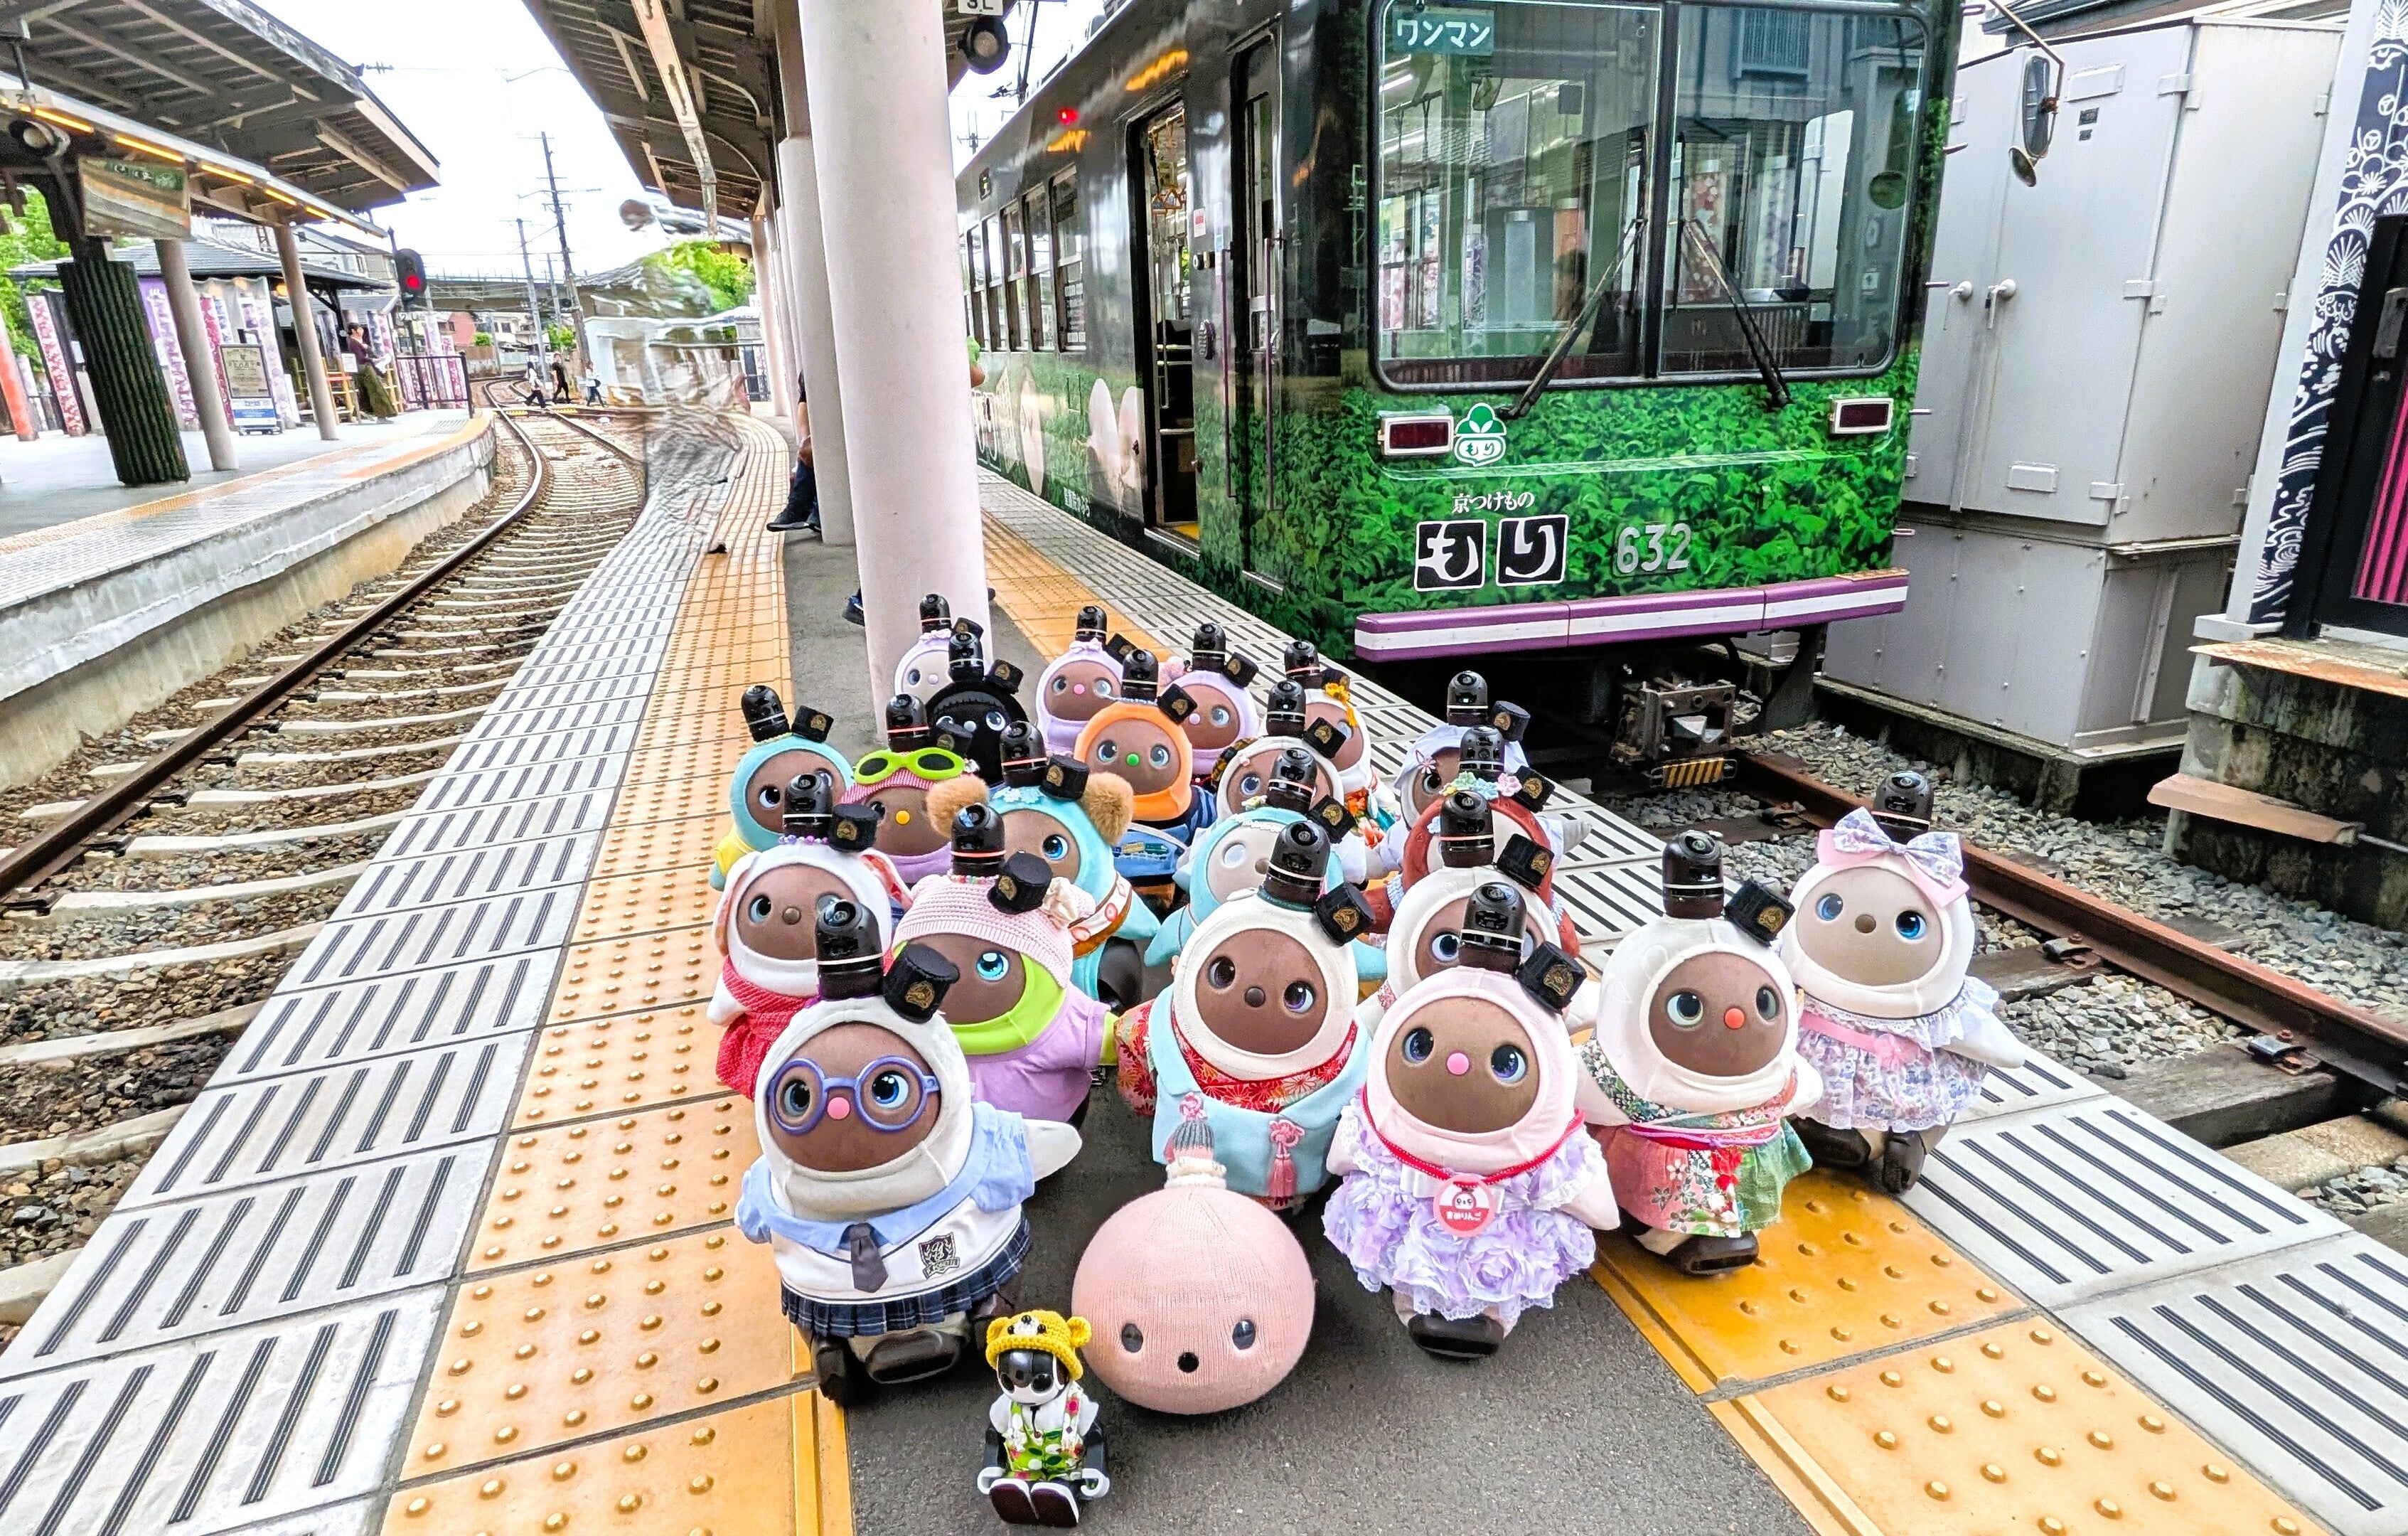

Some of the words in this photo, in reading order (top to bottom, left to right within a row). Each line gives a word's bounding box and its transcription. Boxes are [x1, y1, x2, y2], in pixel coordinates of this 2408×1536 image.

[1397, 19, 1490, 48] ワンマン
[1466, 442, 1495, 456] もり
[1451, 491, 1535, 513] 京つけもの
[1417, 519, 1558, 582] もり
[1617, 523, 1691, 573] 632
